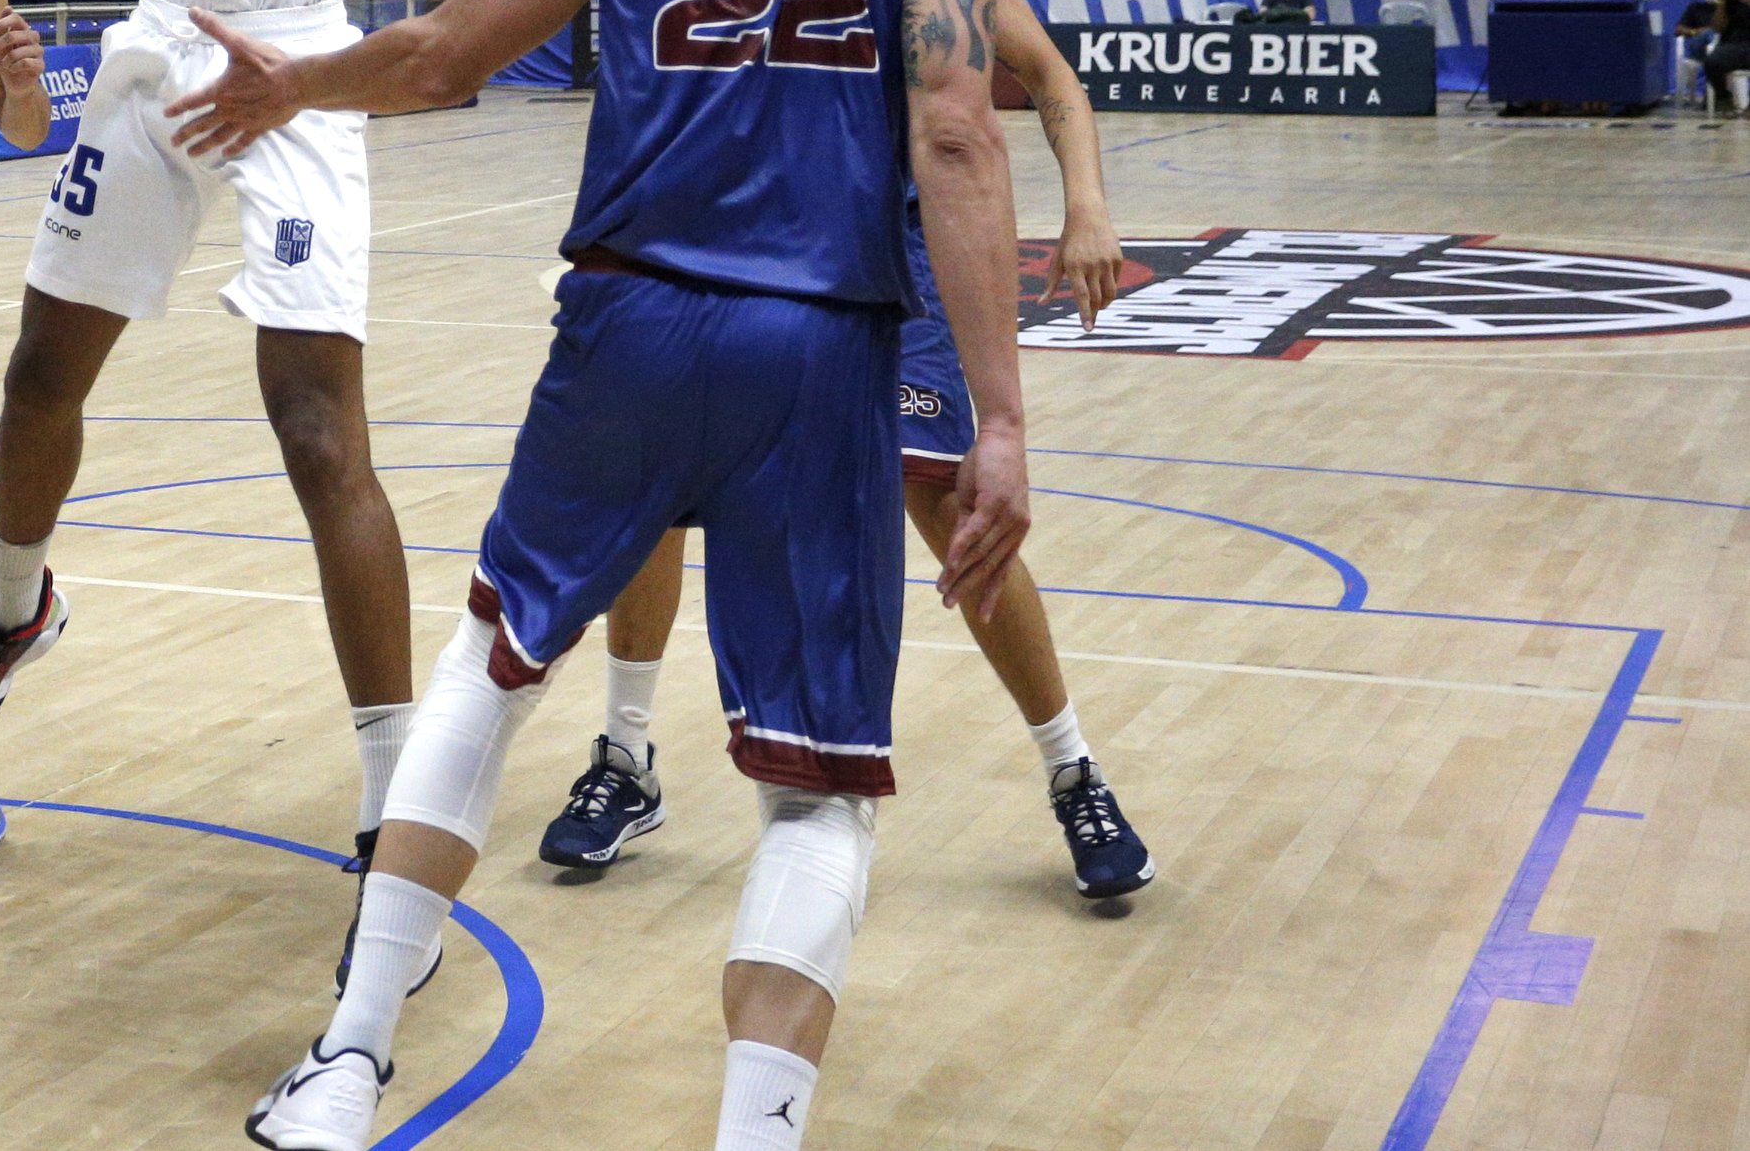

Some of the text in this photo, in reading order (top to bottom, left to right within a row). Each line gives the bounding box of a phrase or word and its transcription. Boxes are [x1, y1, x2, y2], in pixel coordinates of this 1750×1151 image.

[1078, 31, 1381, 77] KRUG BIER
[898, 384, 942, 419] 25
